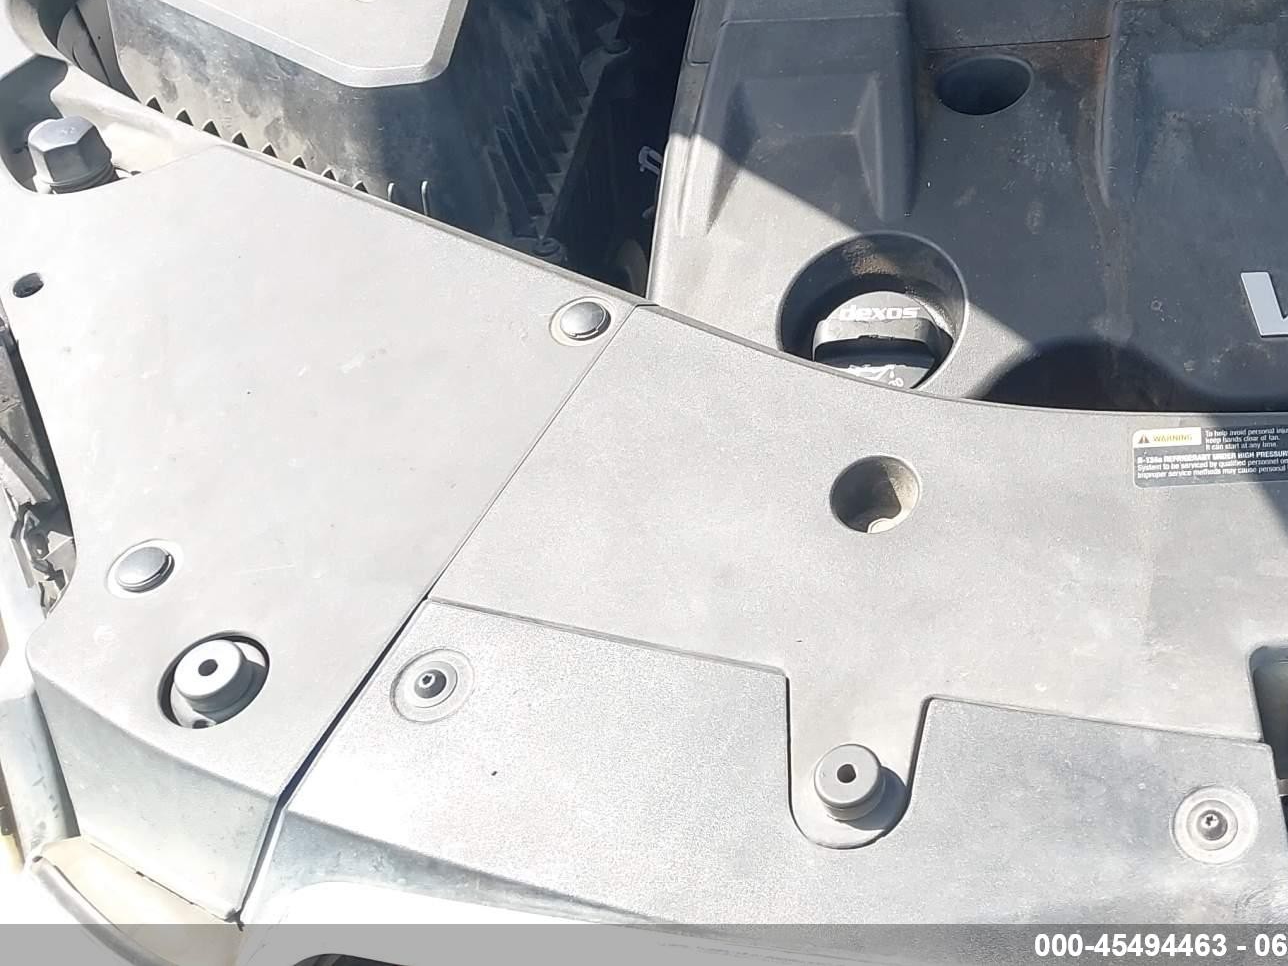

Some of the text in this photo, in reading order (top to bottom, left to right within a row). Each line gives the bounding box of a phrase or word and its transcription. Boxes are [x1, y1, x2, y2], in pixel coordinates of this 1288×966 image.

[839, 304, 920, 321] dexos
[1214, 429, 1227, 438] help
[1248, 428, 1275, 436] personal
[1152, 435, 1192, 443] WARNING
[1248, 442, 1261, 450] any
[1213, 452, 1236, 460] UNDER
[1181, 461, 1208, 469] serviced
[1219, 459, 1245, 469] qualified
[1248, 459, 1278, 467] personnel
[1193, 468, 1221, 476] methods
[1259, 466, 1286, 474] personal
